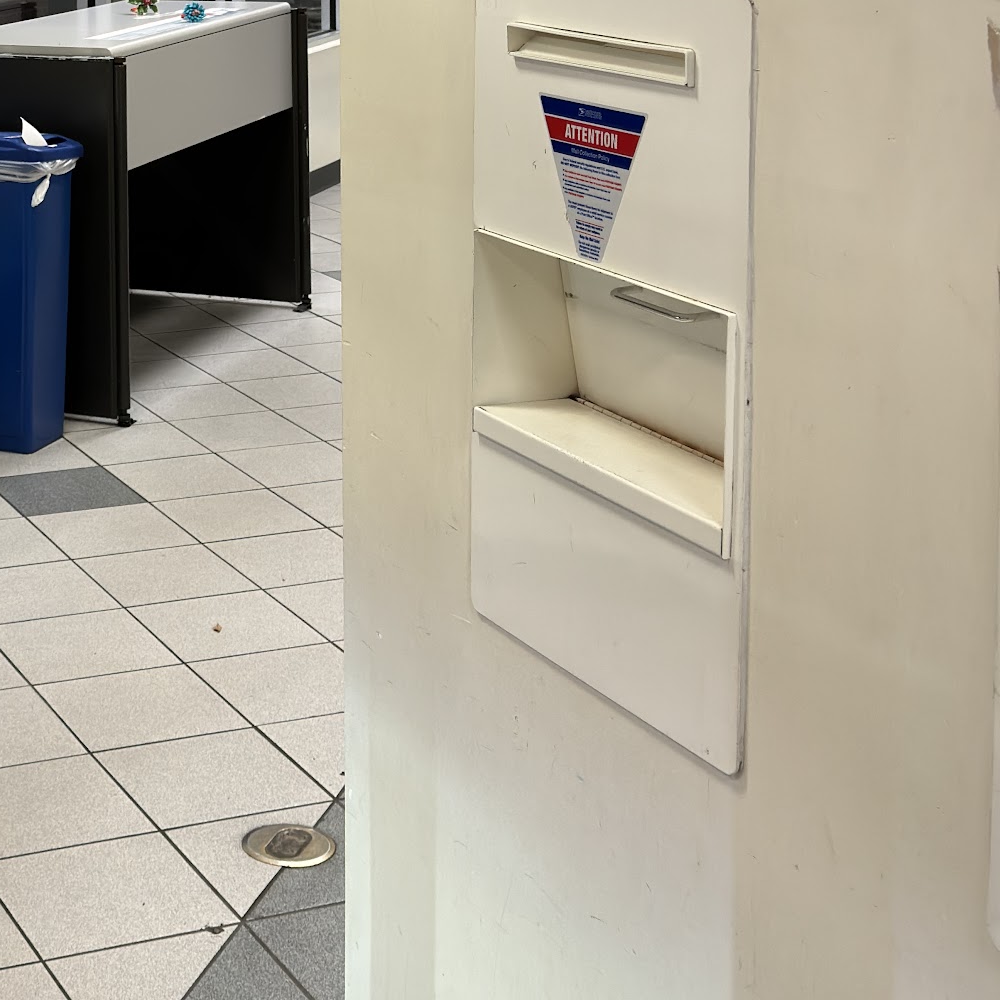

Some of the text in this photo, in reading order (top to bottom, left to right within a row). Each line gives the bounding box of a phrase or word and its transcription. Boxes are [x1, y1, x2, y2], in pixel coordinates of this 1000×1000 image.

[565, 123, 618, 149] ATTENTION
[580, 149, 597, 159] Collection
[597, 153, 610, 162] Policy
